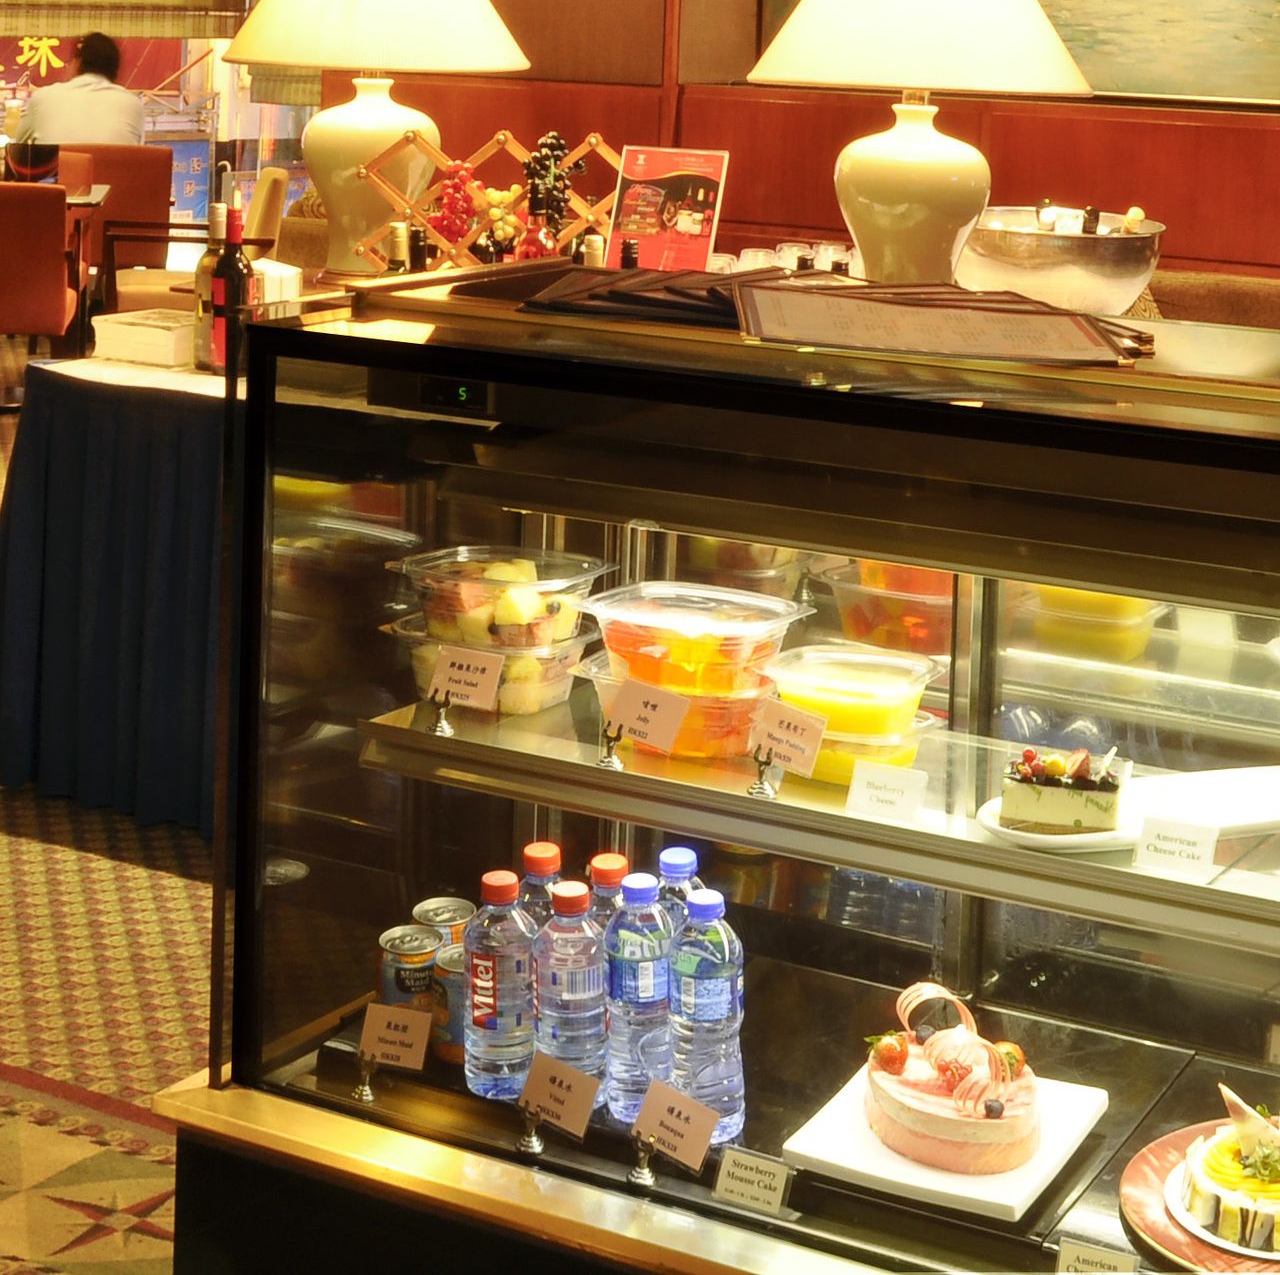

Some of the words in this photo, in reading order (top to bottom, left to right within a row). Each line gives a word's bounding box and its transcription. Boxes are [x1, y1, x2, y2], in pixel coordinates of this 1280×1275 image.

[1155, 833, 1198, 846] American
[1146, 843, 1176, 856] Cheese
[1179, 850, 1201, 861] Cake
[732, 1159, 776, 1181] Strawberry
[727, 1170, 755, 1186] Mousse
[757, 1180, 777, 1192] Cake
[1075, 1255, 1118, 1272] American
